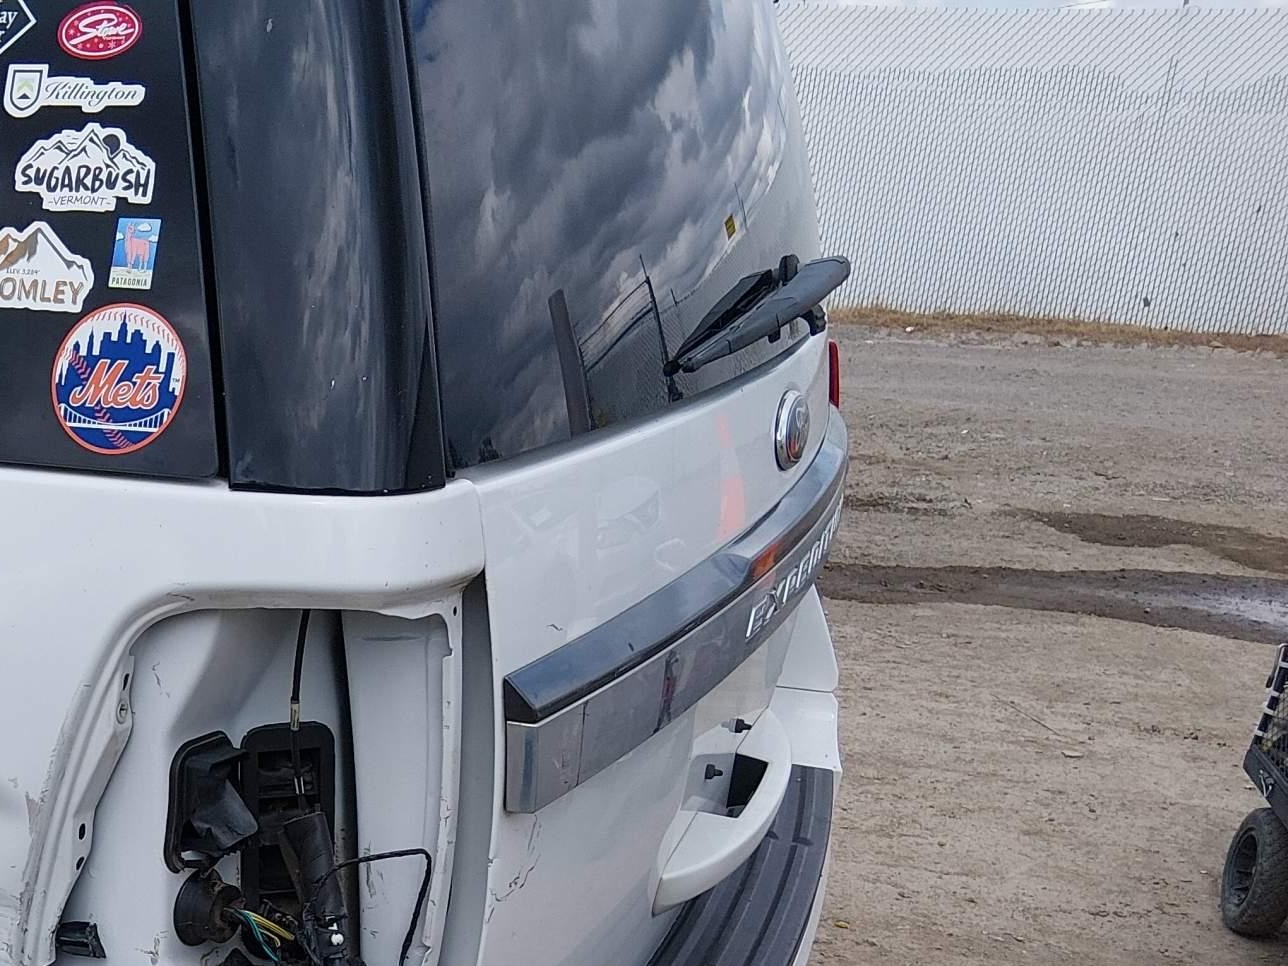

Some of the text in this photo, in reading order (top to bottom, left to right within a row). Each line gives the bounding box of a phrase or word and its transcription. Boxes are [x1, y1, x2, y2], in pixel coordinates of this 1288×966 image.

[45, 81, 137, 107] Killington
[20, 163, 151, 198] SUGARBUSH
[111, 277, 148, 287] PATAGONIA
[70, 360, 164, 410] Mets
